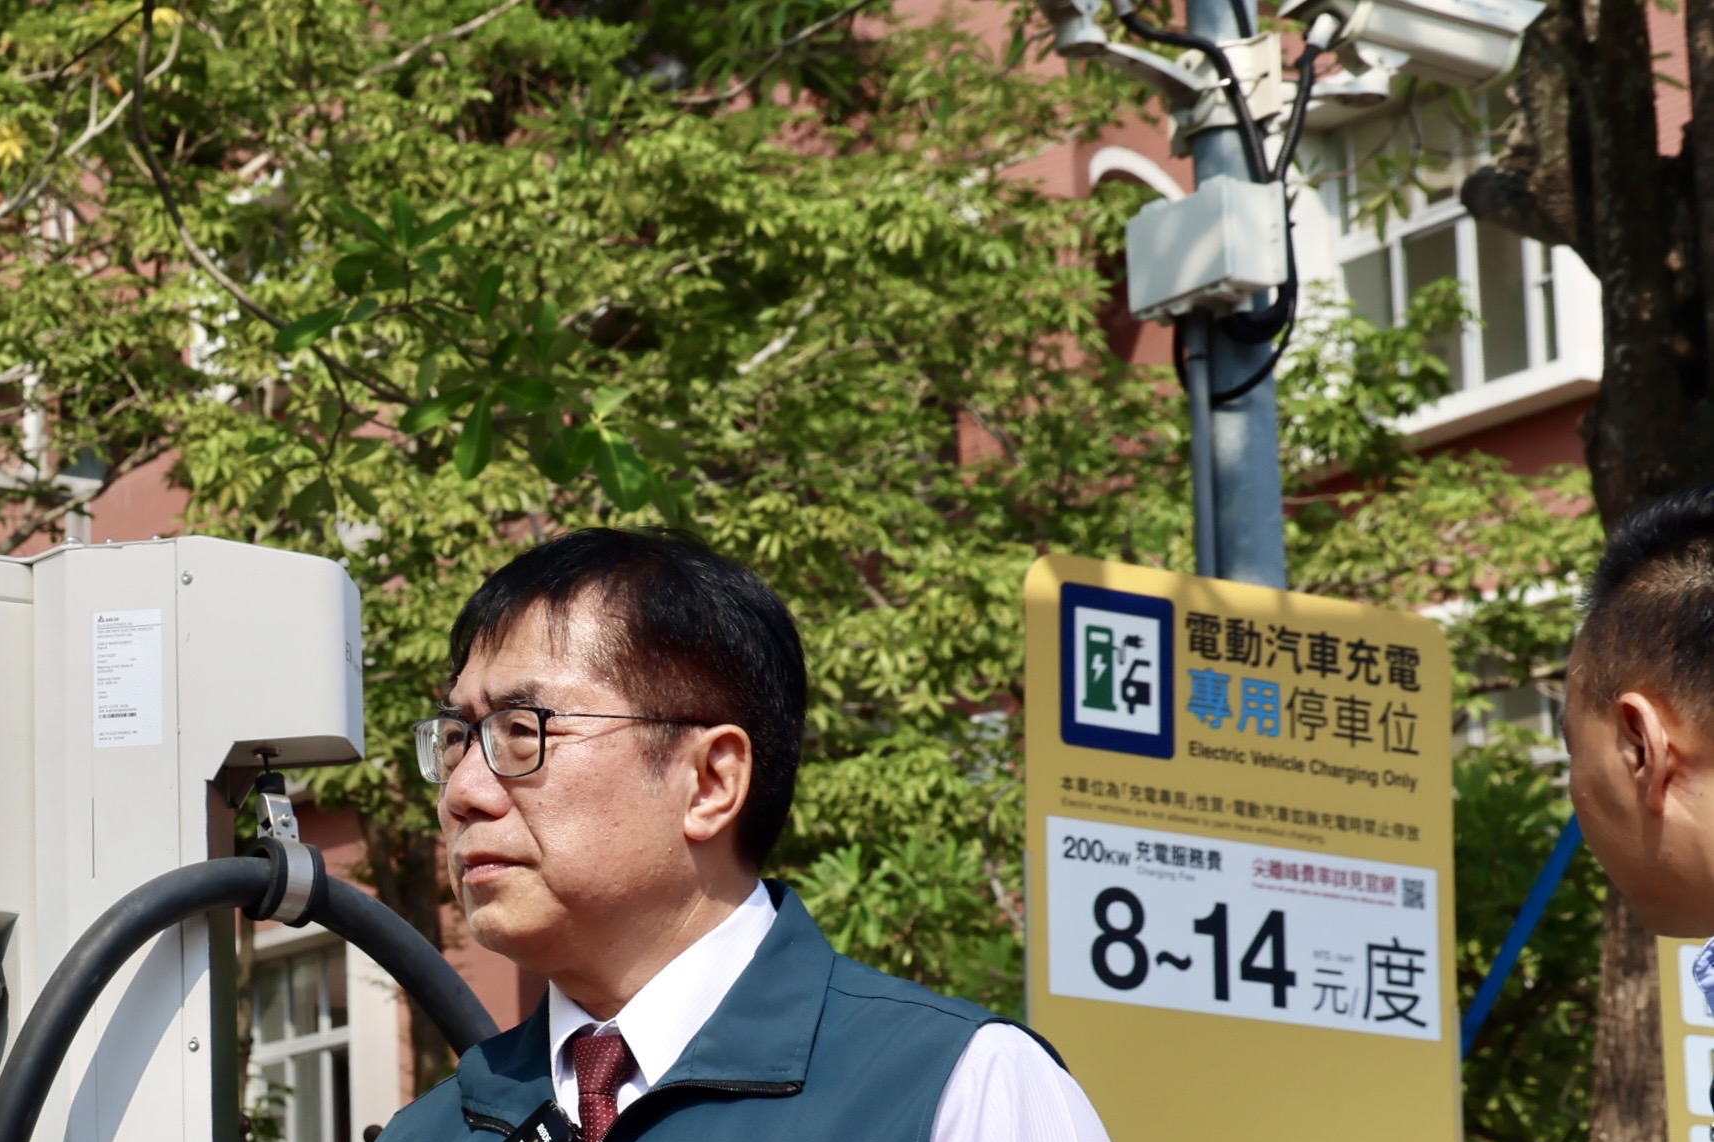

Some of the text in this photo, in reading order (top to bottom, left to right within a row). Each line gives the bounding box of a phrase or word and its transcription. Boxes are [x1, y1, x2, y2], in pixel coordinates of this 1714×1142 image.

[1186, 610, 1422, 693] 電動汽車充電
[1187, 667, 1421, 757] 專用停車位
[1188, 740, 1419, 793] Electric Vehicle Charging Only
[1136, 840, 1223, 872] 充電服務費
